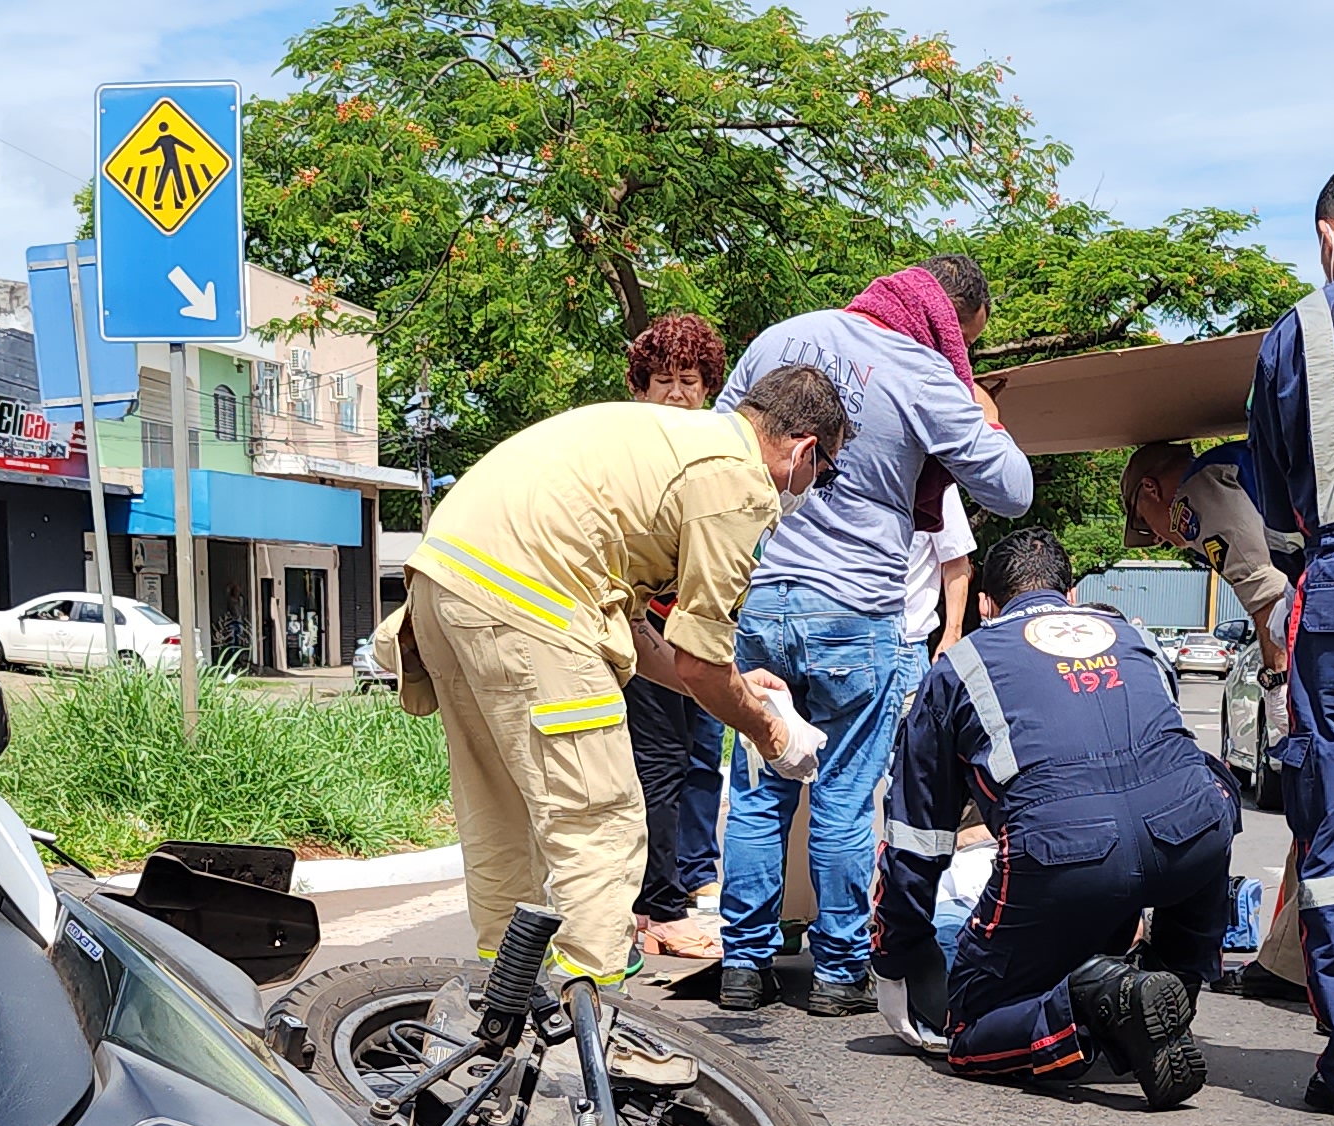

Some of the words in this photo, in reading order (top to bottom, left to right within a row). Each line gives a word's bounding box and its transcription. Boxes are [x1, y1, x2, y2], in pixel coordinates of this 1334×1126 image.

[779, 337, 875, 392] LUAN
[1056, 655, 1118, 675] SAMU
[1063, 668, 1124, 694] 192
